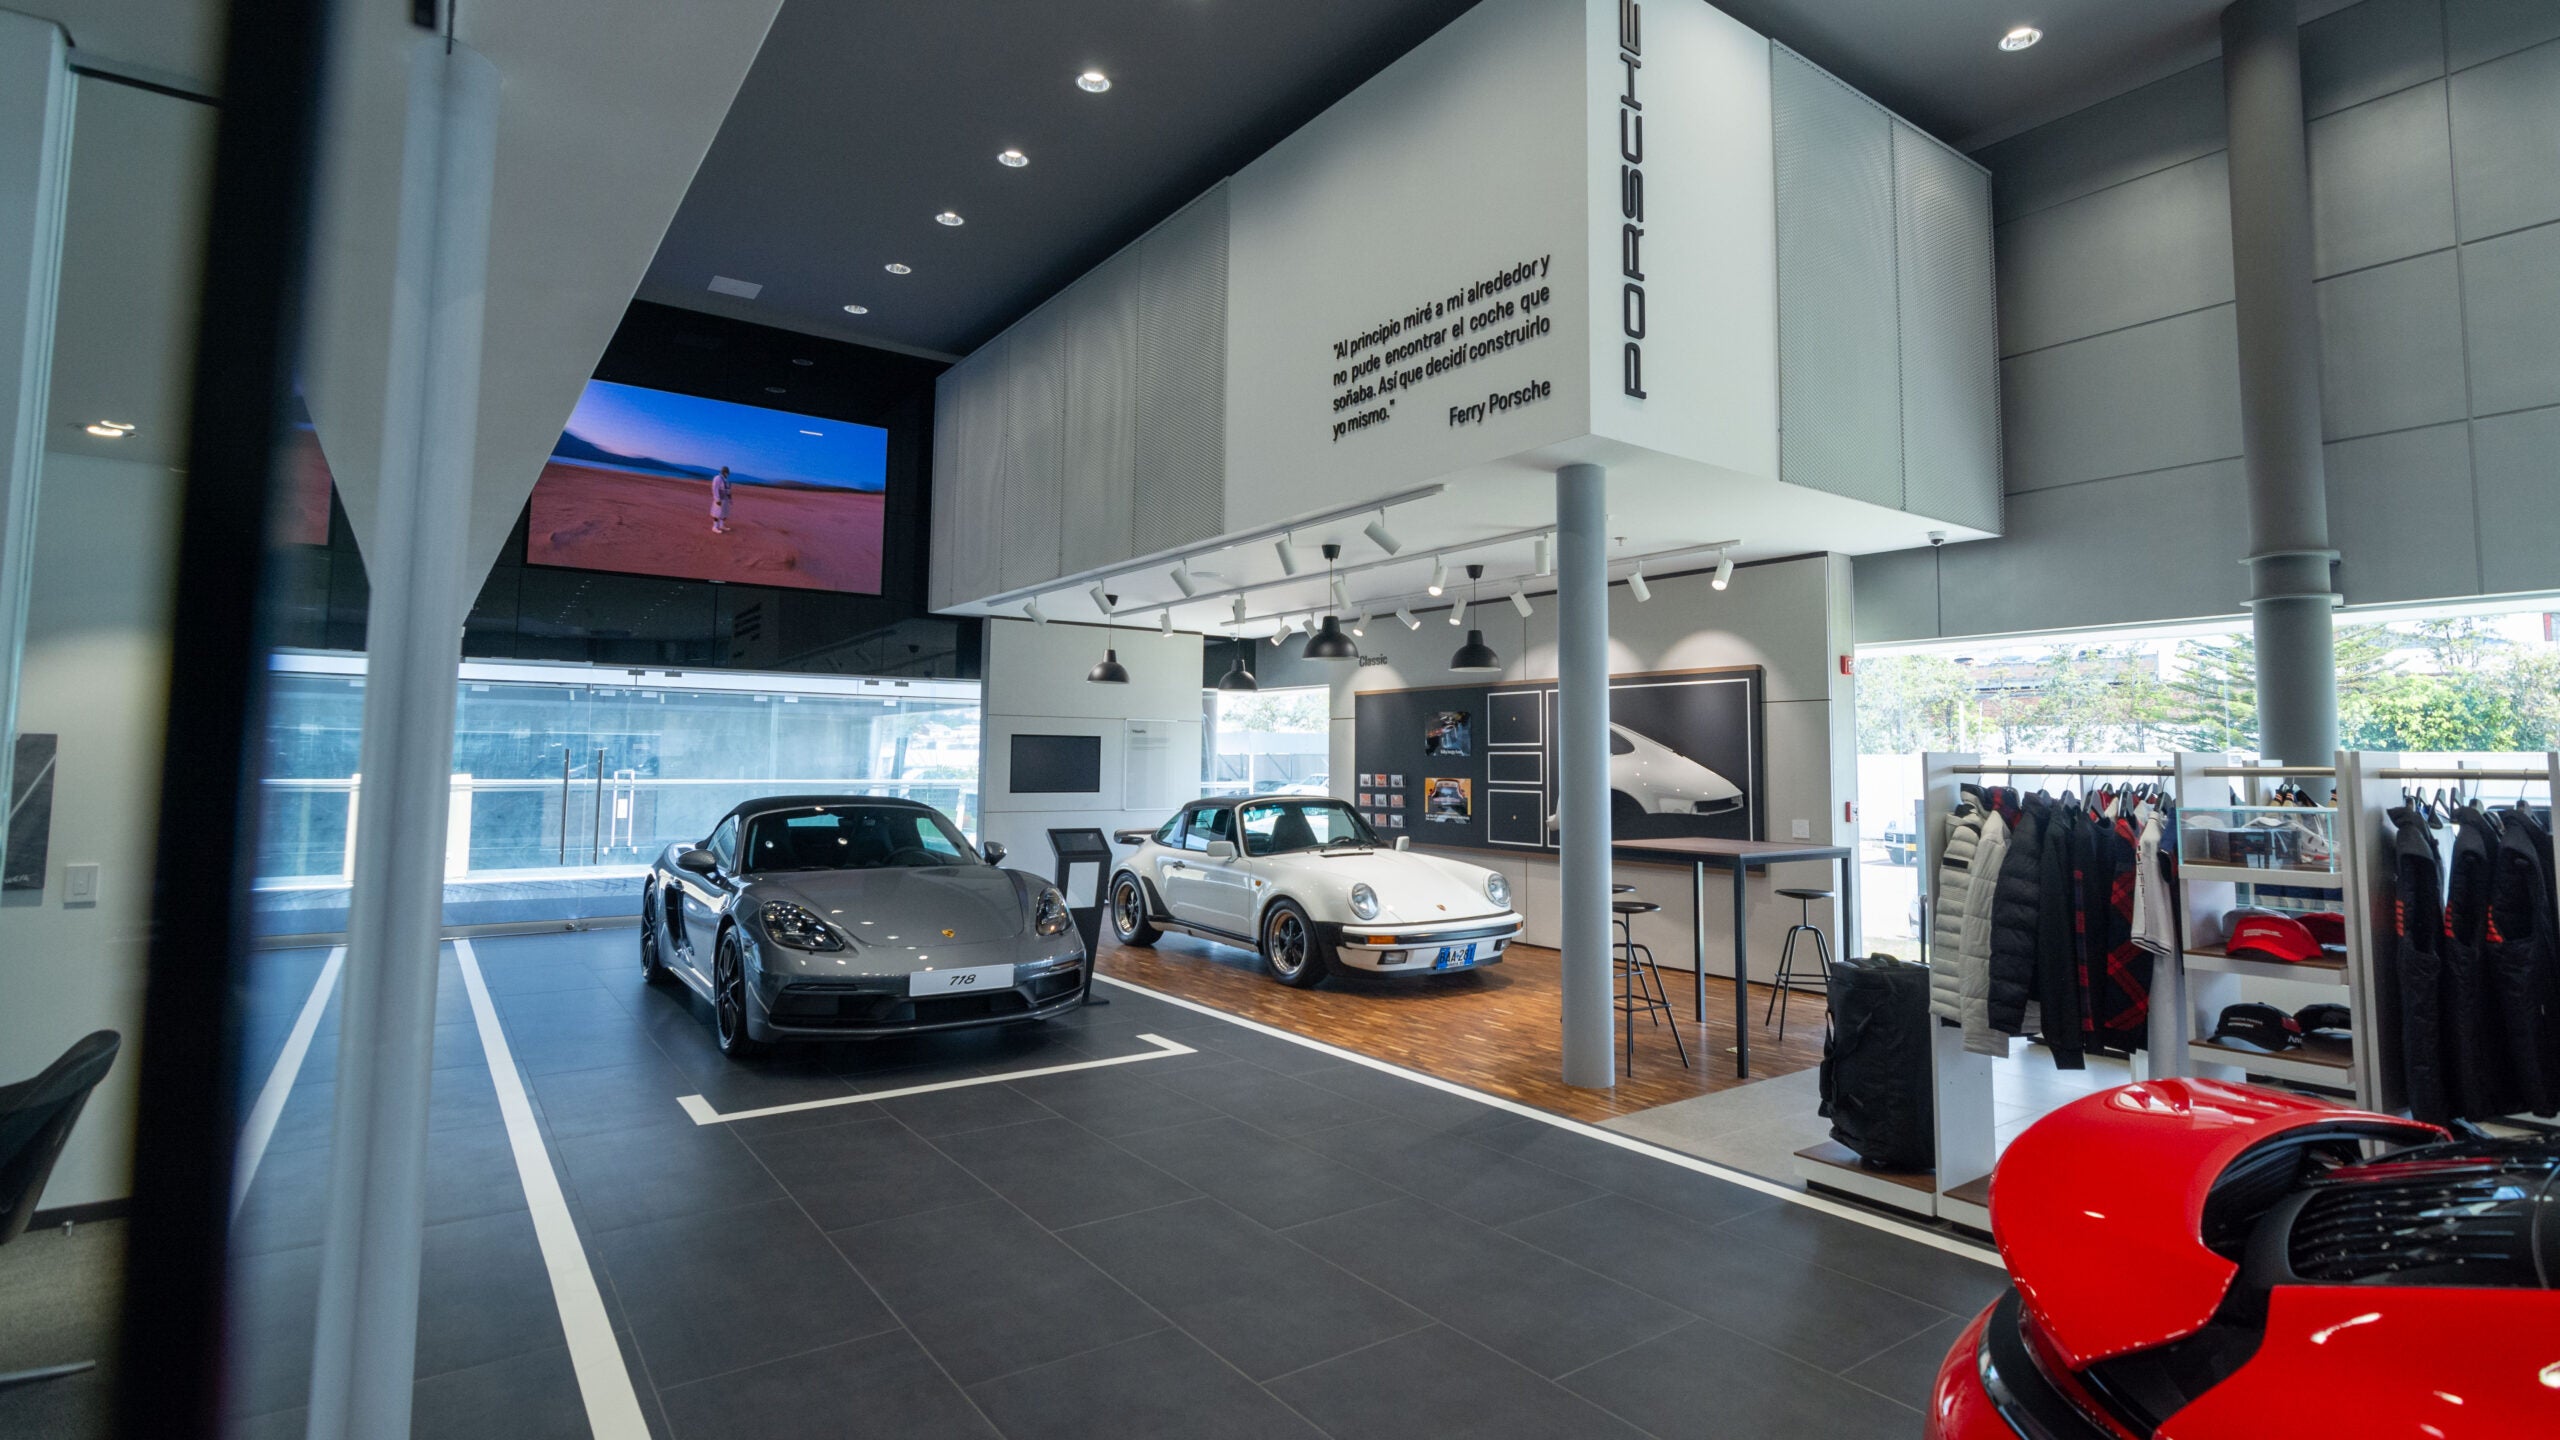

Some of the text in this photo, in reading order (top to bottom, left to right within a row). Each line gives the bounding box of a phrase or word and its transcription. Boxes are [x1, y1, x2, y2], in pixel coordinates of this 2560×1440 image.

[1620, 0, 1647, 400] PORSCHE
[1333, 286, 1550, 386] no pude encontrar el coche que
[1351, 319, 1401, 359] principio
[1403, 301, 1433, 331] miré
[1435, 302, 1443, 317] a
[1447, 287, 1464, 312] mi
[1467, 259, 1538, 303] alrededor
[1540, 254, 1551, 278] y
[1333, 315, 1550, 412] soñaba. Así que decidí construirlo
[1332, 421, 1347, 442] yo
[1449, 379, 1551, 427] Ferry Porsche
[1359, 653, 1388, 668] Classic
[949, 973, 977, 986] 718
